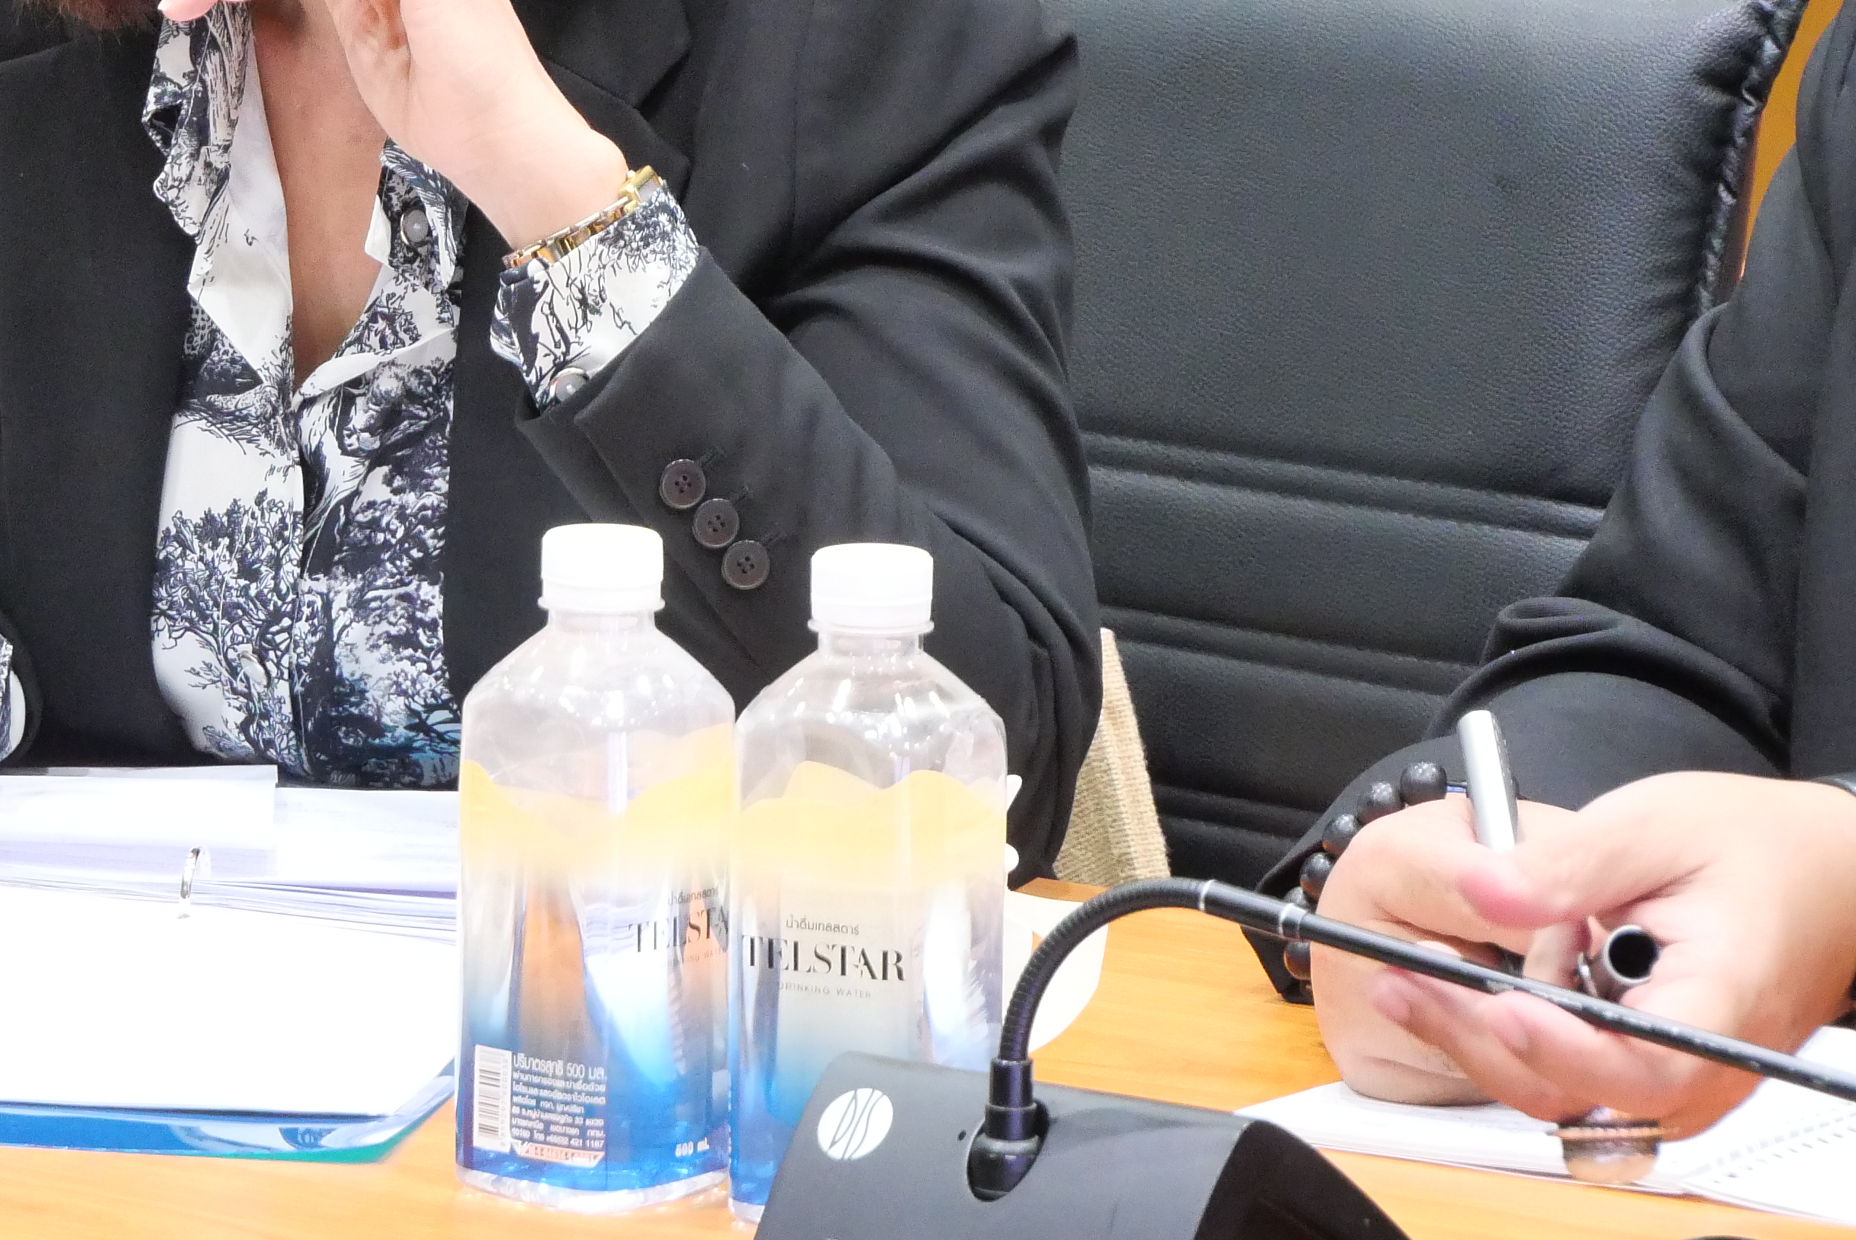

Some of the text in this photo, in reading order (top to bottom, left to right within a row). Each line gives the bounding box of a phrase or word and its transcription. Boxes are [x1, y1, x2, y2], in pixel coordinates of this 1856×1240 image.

[628, 905, 729, 953] TELSTA
[742, 934, 906, 982] TELSTAR
[778, 981, 873, 1000] DRINKING WATER
[566, 1062, 585, 1079] 500
